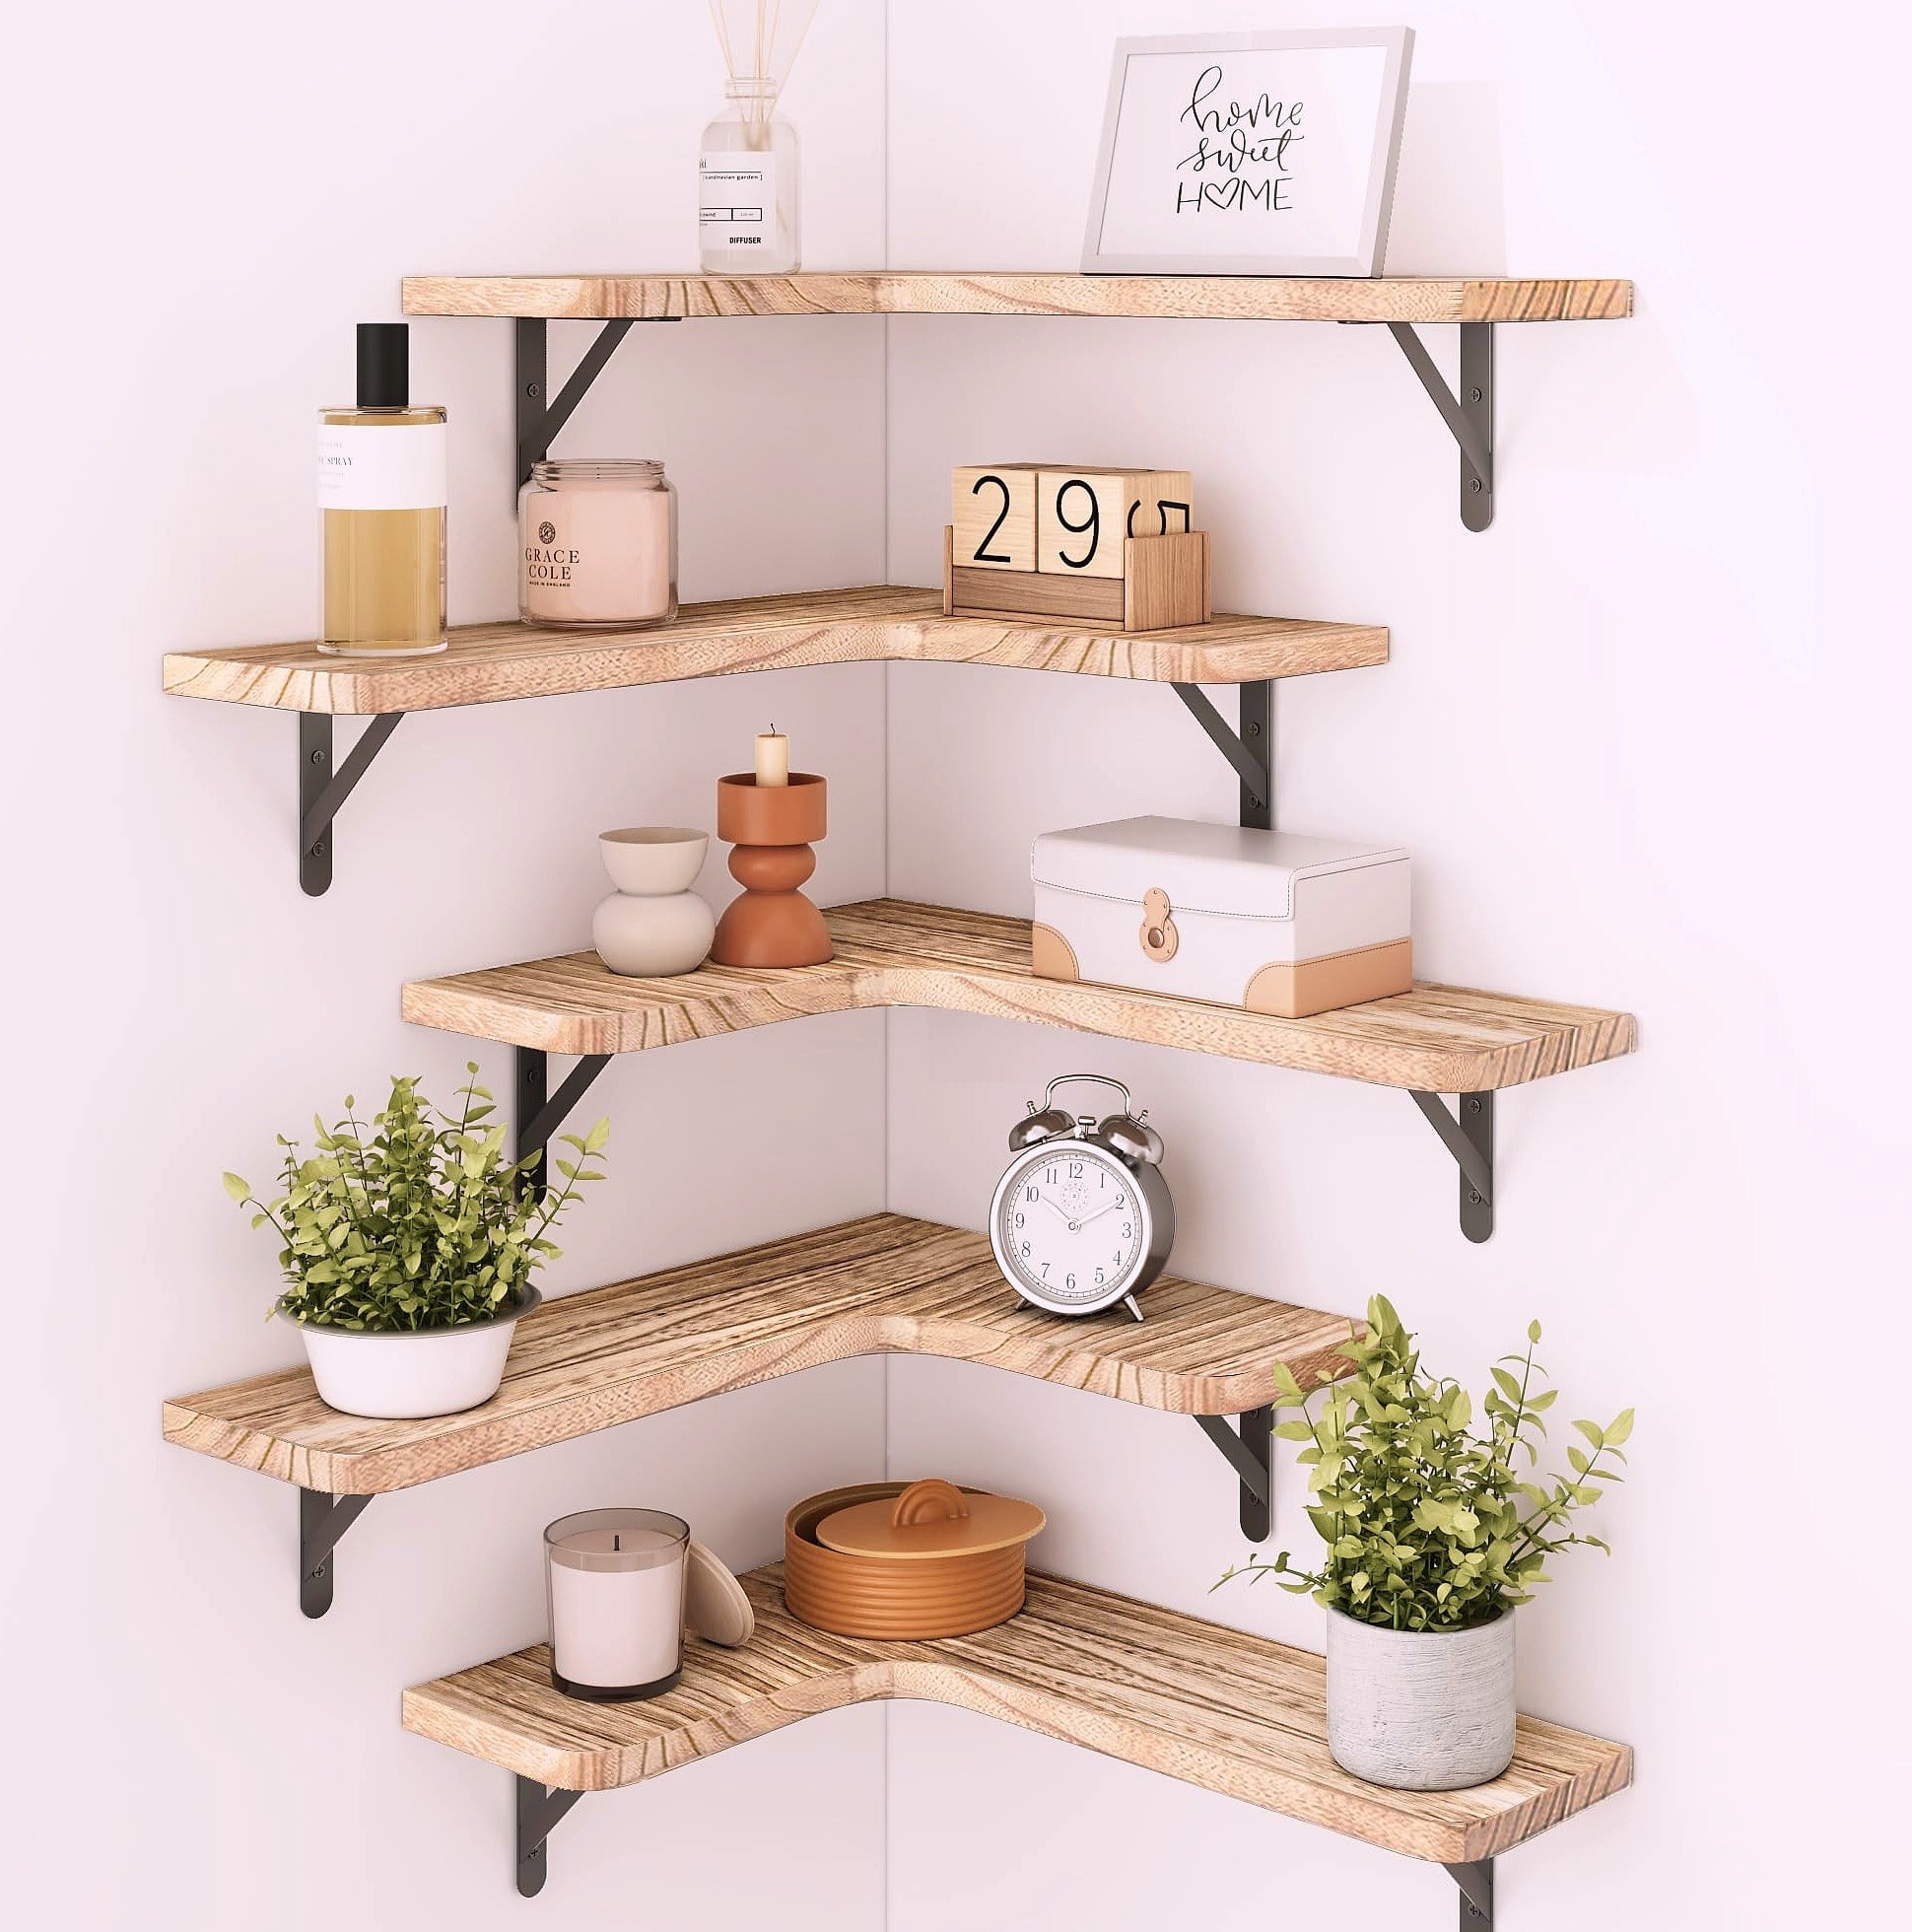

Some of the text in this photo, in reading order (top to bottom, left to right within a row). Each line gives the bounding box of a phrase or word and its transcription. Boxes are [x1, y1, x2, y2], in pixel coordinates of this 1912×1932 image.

[1180, 65, 1304, 132] home
[1176, 128, 1305, 173] sweet
[327, 456, 355, 466] SPRAY
[525, 547, 580, 564] GRACE
[528, 564, 572, 580] COLE
[1046, 1168, 1058, 1185] 11
[1069, 1162, 1083, 1179] 12
[1100, 1172, 1105, 1189] 1
[1026, 1186, 1040, 1203] 10
[1115, 1193, 1126, 1210] 2
[1015, 1212, 1026, 1229] 9
[1122, 1221, 1132, 1239] 3
[1021, 1240, 1032, 1258] 8
[1112, 1250, 1122, 1266] 4
[1041, 1262, 1051, 1278] 7
[1094, 1267, 1105, 1284] 5
[1065, 1273, 1076, 1290] 6
